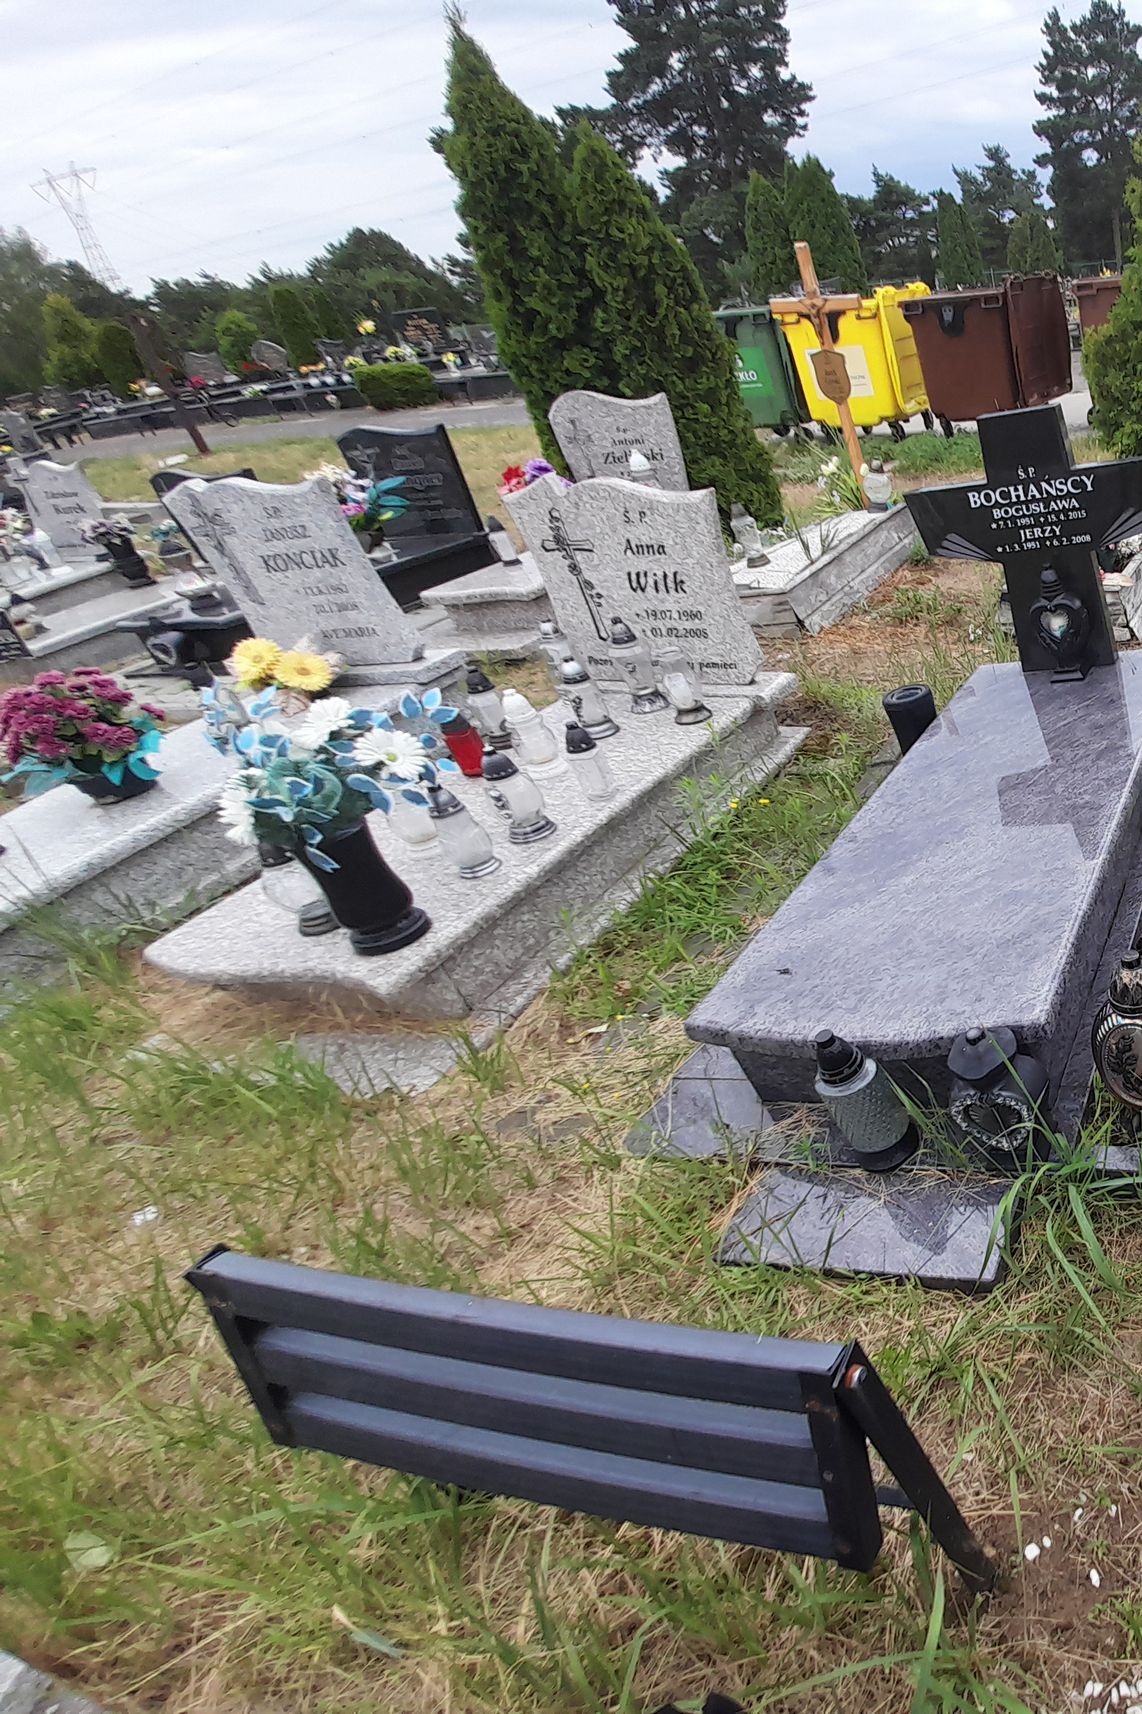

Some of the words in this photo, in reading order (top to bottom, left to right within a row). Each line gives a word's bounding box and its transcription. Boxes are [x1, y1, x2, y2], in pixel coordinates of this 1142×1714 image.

[611, 435, 645, 447] Antoni
[967, 474, 1094, 508] BOCHAŃSCY
[992, 498, 1080, 519] BOGUSŁAWA
[1016, 516, 1035, 527] 1951
[1068, 510, 1087, 520] 2015
[1019, 524, 1062, 542] JERZY
[623, 538, 667, 556] Anna
[1022, 541, 1040, 551] 1951
[1071, 534, 1092, 544] 2008
[626, 570, 688, 594] Wilk
